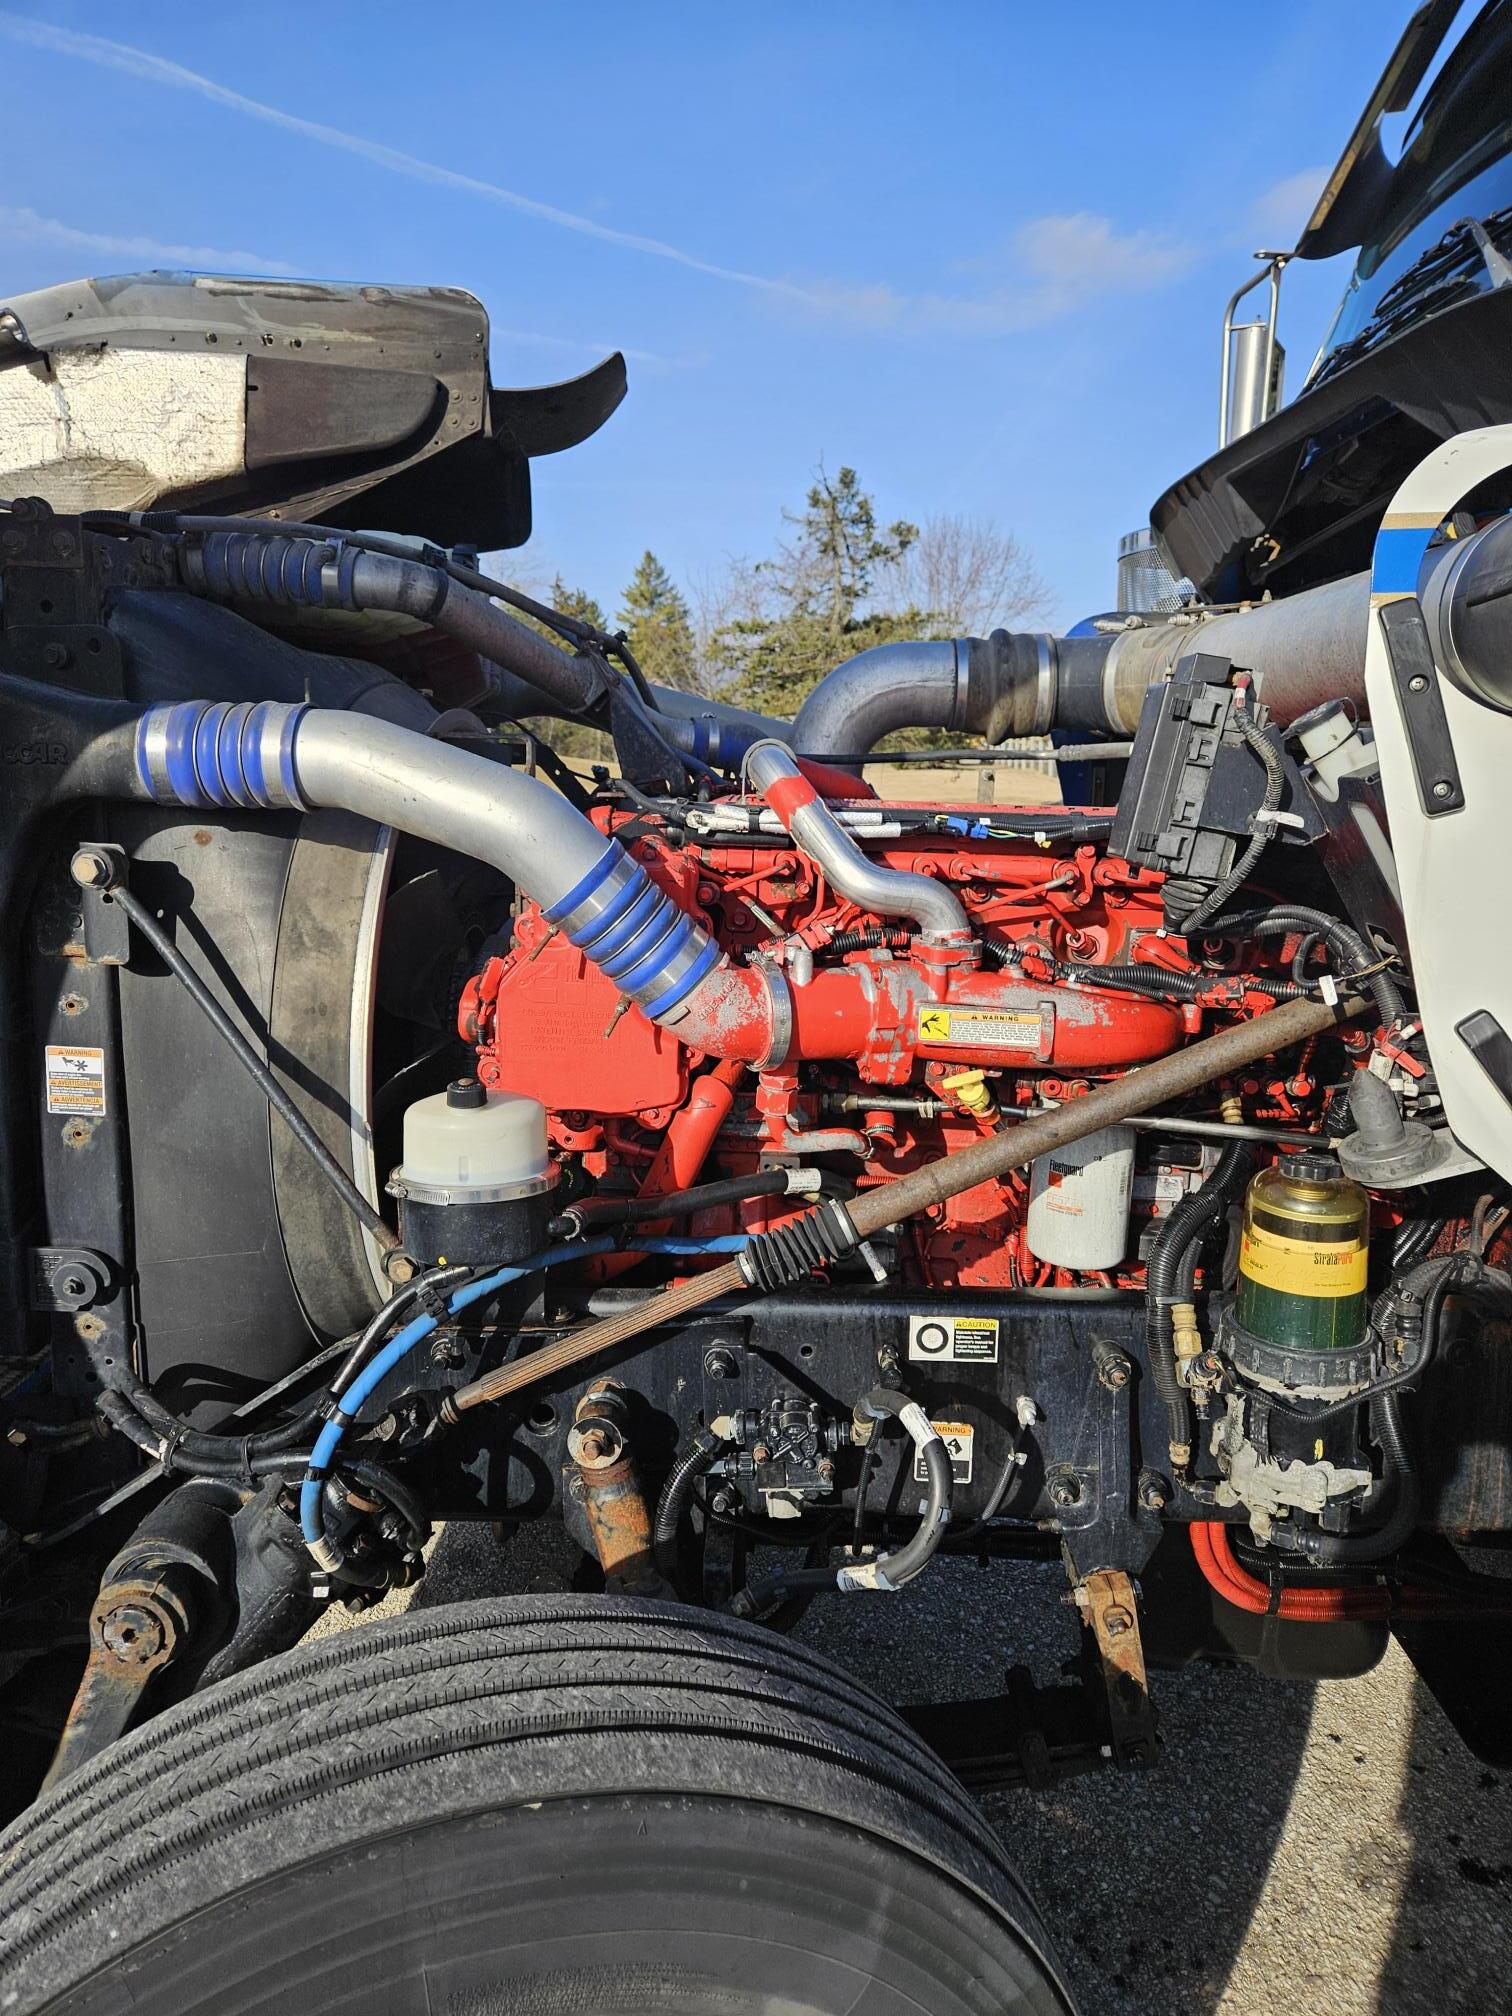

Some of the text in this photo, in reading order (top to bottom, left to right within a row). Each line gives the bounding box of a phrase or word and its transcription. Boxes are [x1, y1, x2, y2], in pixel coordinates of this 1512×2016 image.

[982, 1014, 1019, 1022] WARNING
[1049, 1158, 1084, 1177] Fleetguard
[961, 1321, 996, 1329] CAUTION
